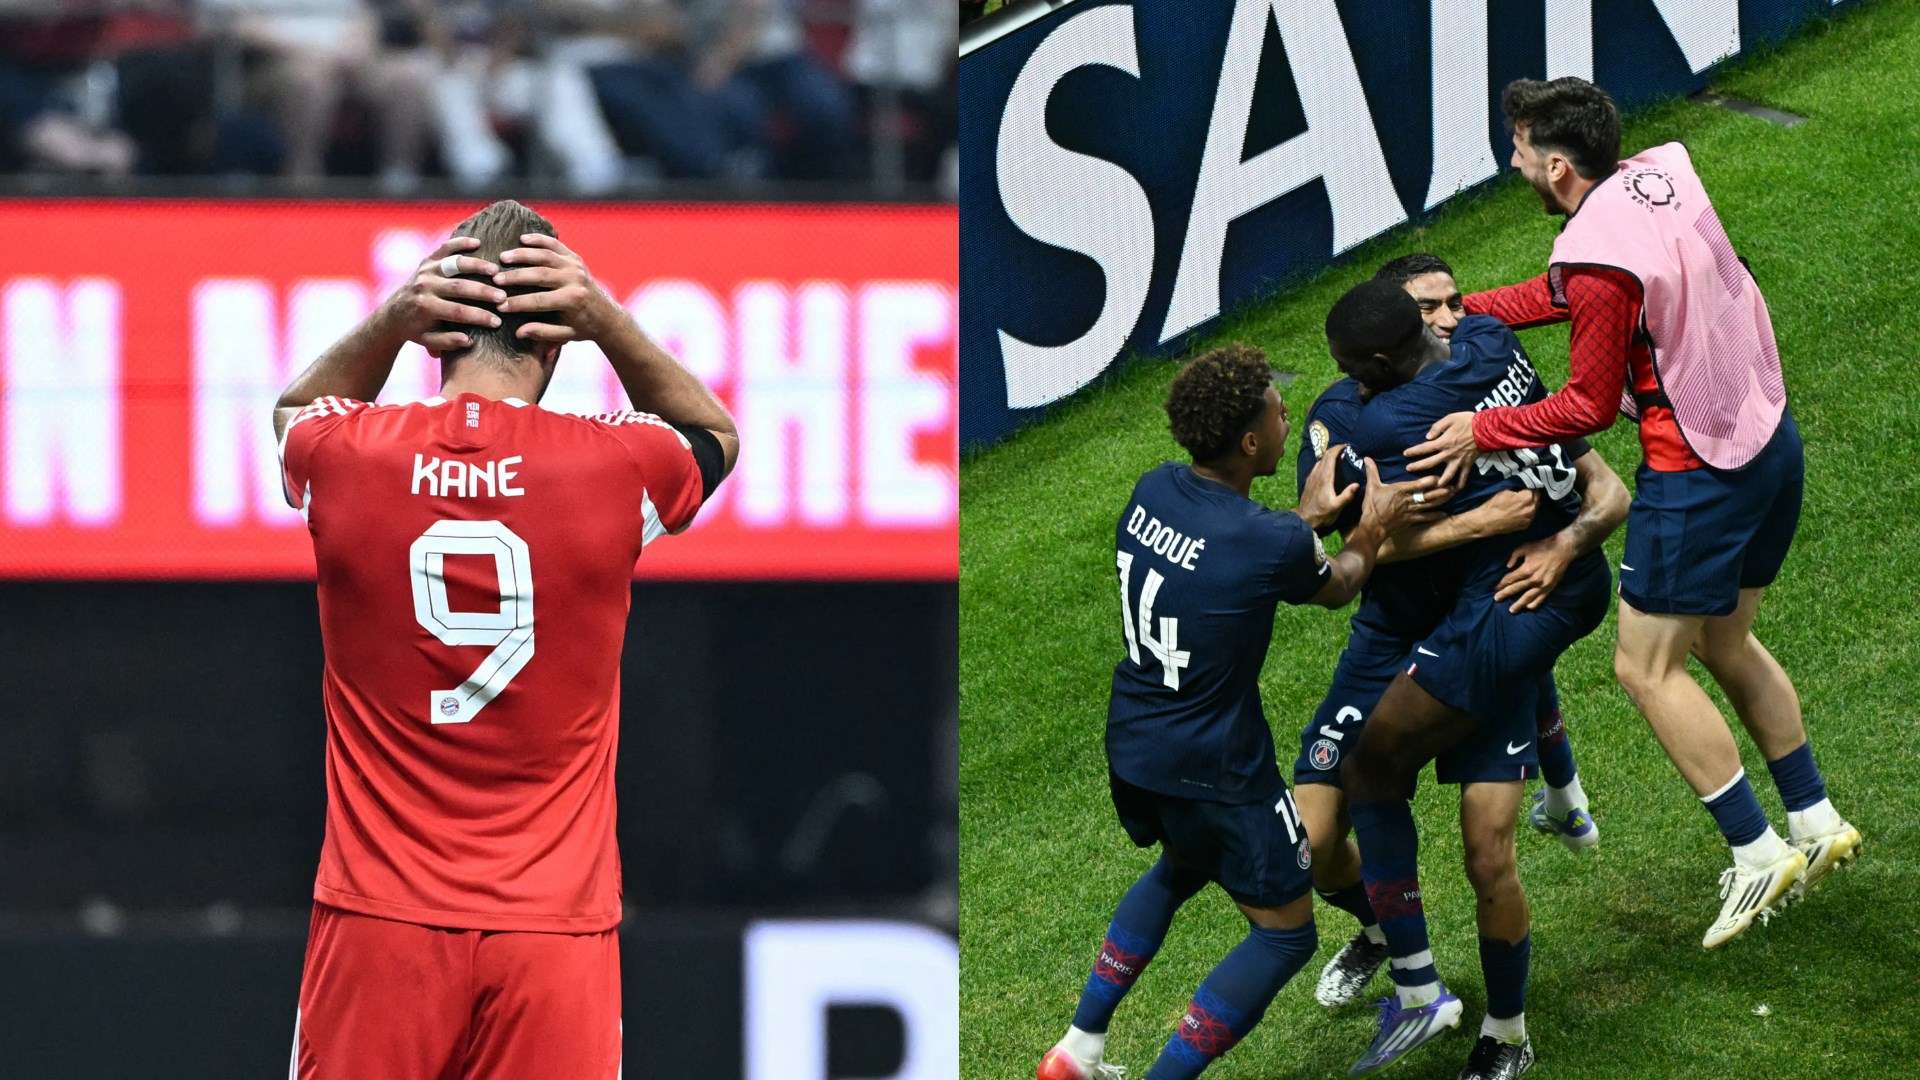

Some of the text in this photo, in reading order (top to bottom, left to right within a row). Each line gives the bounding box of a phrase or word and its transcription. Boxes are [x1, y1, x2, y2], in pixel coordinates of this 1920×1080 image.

[190, 228, 955, 526] MHE
[411, 453, 525, 498] KANE
[1126, 504, 1206, 571] D.DOUÉ
[409, 519, 535, 725] 9
[1116, 550, 1191, 691] 14
[1101, 952, 1134, 976] PARIS
